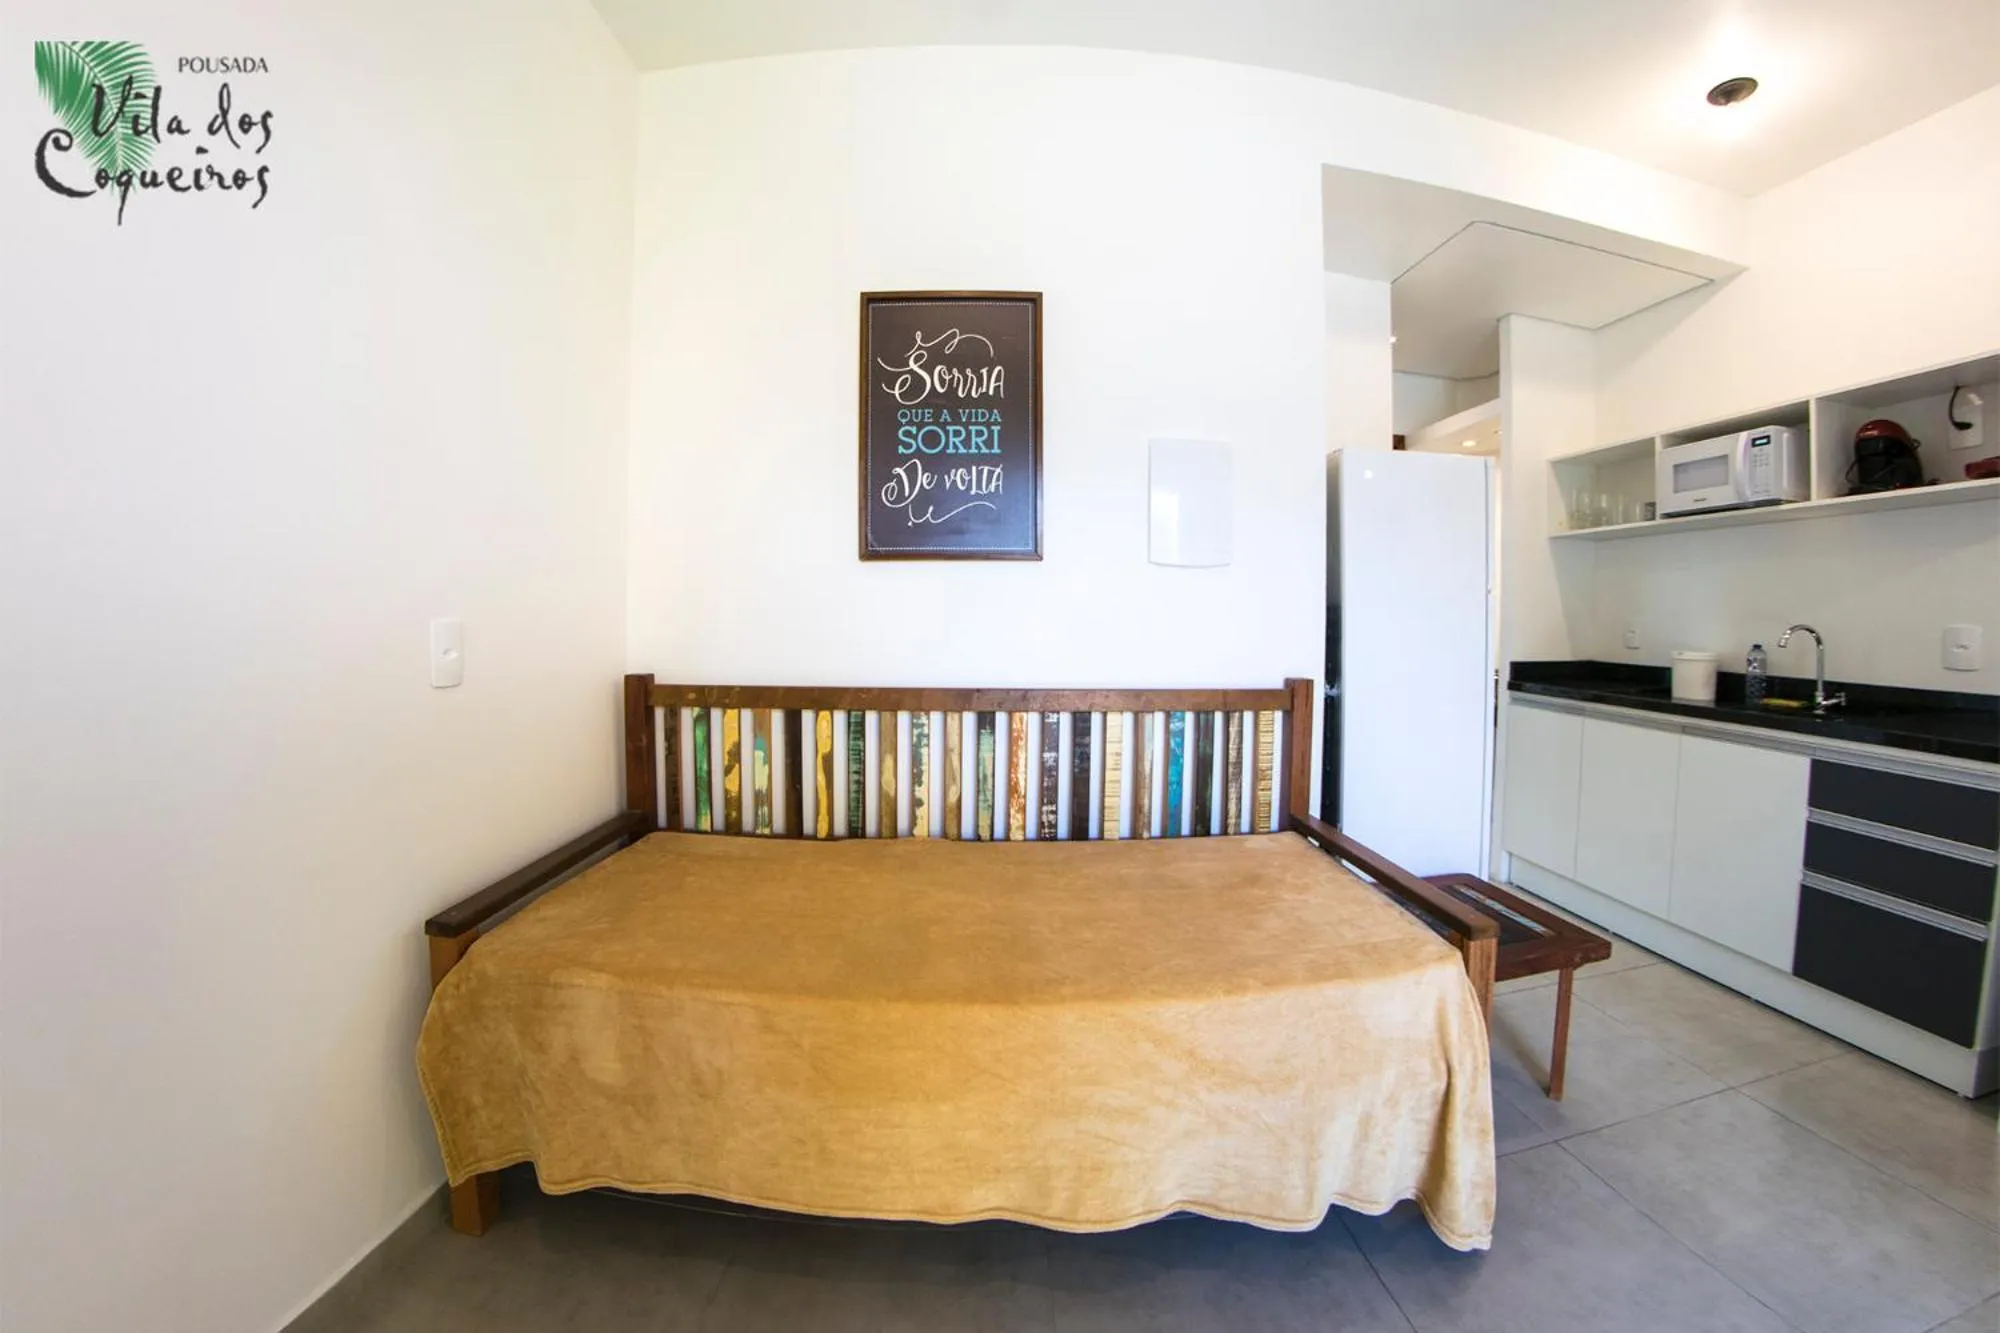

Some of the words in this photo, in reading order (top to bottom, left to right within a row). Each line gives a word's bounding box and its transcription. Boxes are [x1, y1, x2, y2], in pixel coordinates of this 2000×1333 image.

[897, 408, 933, 425] QUE
[940, 409, 952, 423] A
[960, 408, 1002, 423] VIDA
[898, 426, 1002, 455] SORRI
[881, 458, 936, 508] De
